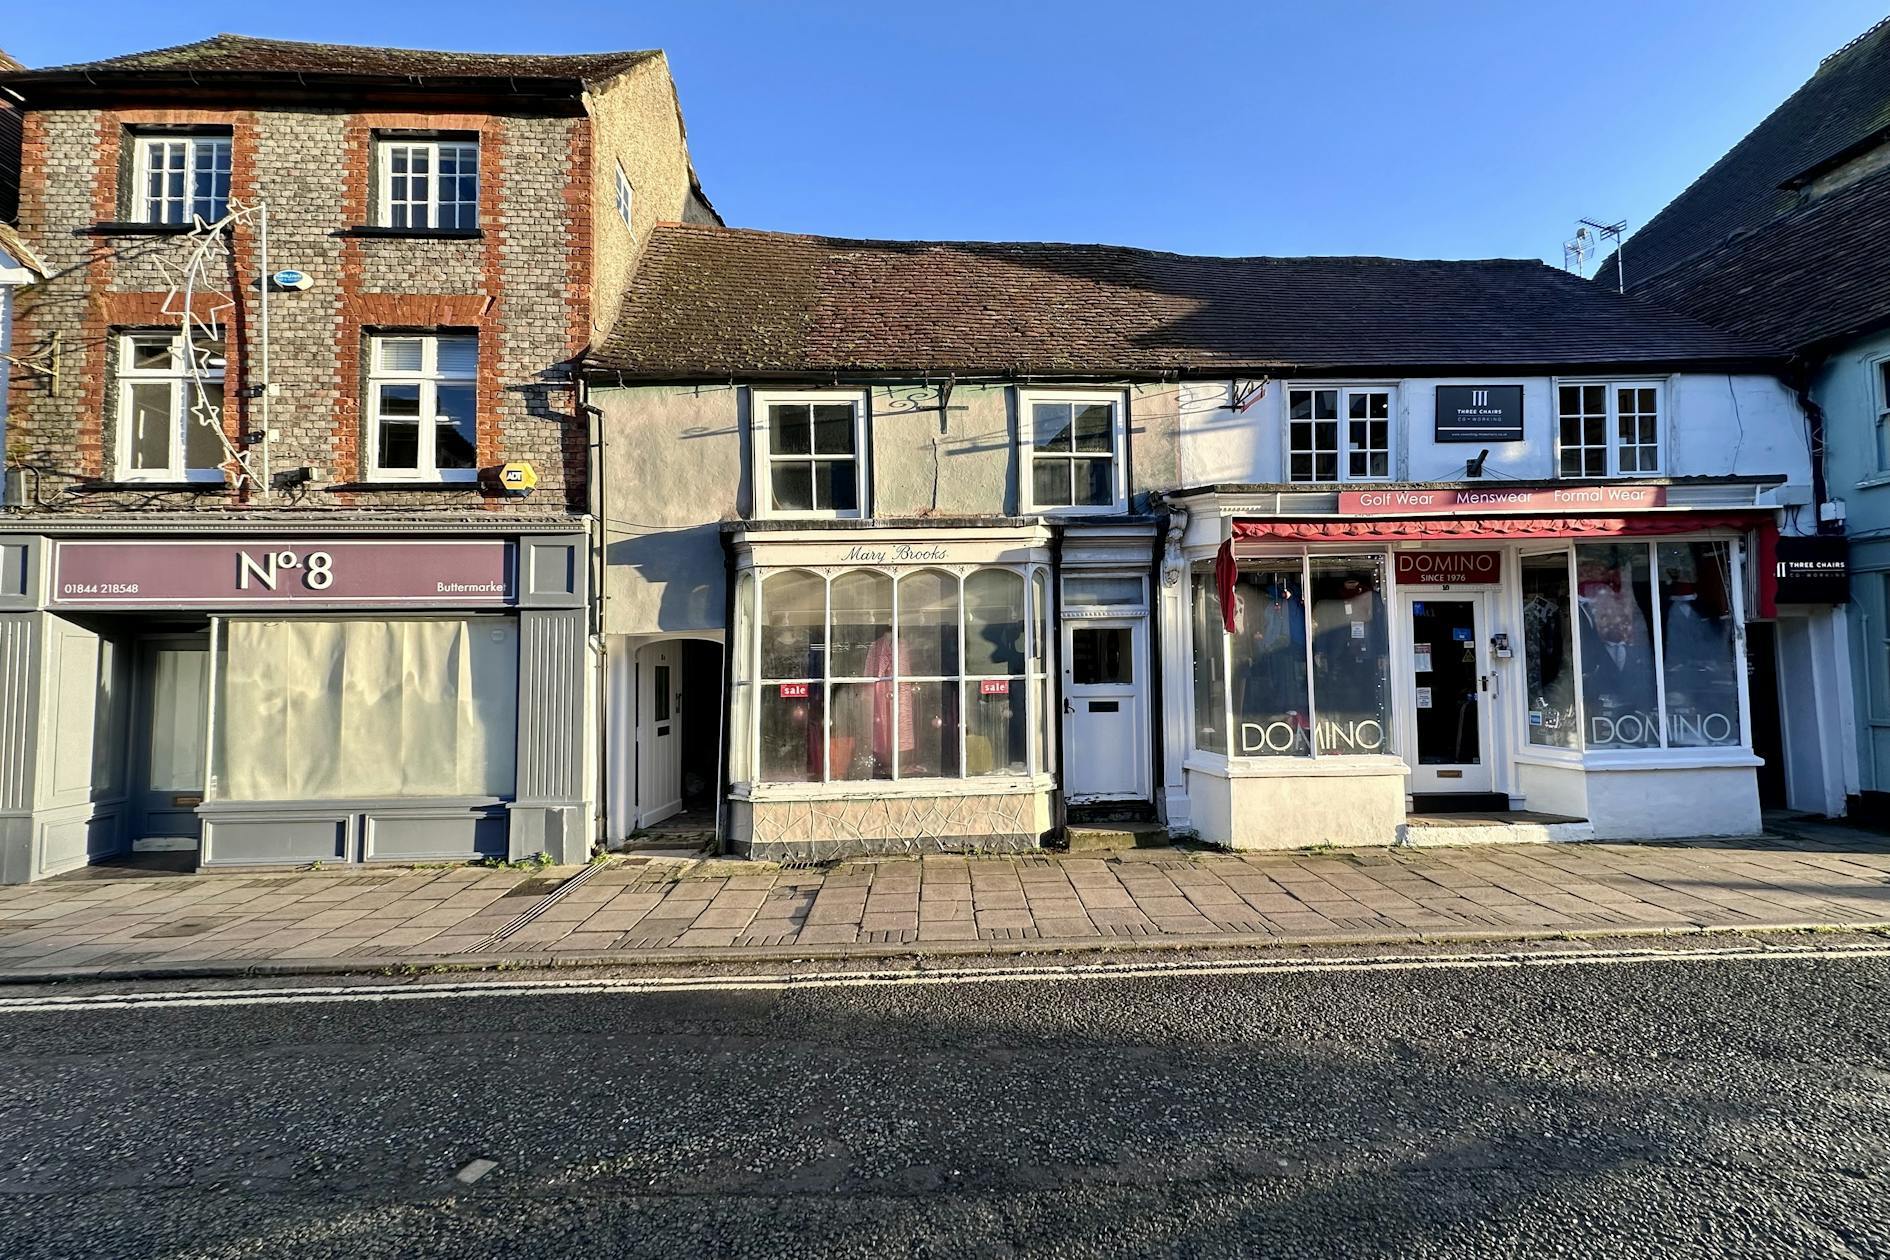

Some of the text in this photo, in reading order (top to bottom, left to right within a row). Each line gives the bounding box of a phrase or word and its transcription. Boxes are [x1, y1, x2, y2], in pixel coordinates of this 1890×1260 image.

[506, 471, 523, 481] ADT
[1360, 488, 1646, 506] Golf Wear Menswear Formal Wear
[841, 545, 947, 564] Mary Brooks
[1400, 555, 1493, 572] DOMINO
[1421, 574, 1466, 582] SINCE 1976
[64, 584, 139, 594] 01844 218548
[437, 580, 507, 592] Buttermarket
[784, 685, 806, 695] sale
[984, 683, 1005, 692] sale
[1592, 713, 1731, 744] DOMINO
[1242, 720, 1383, 751] DOMINO
